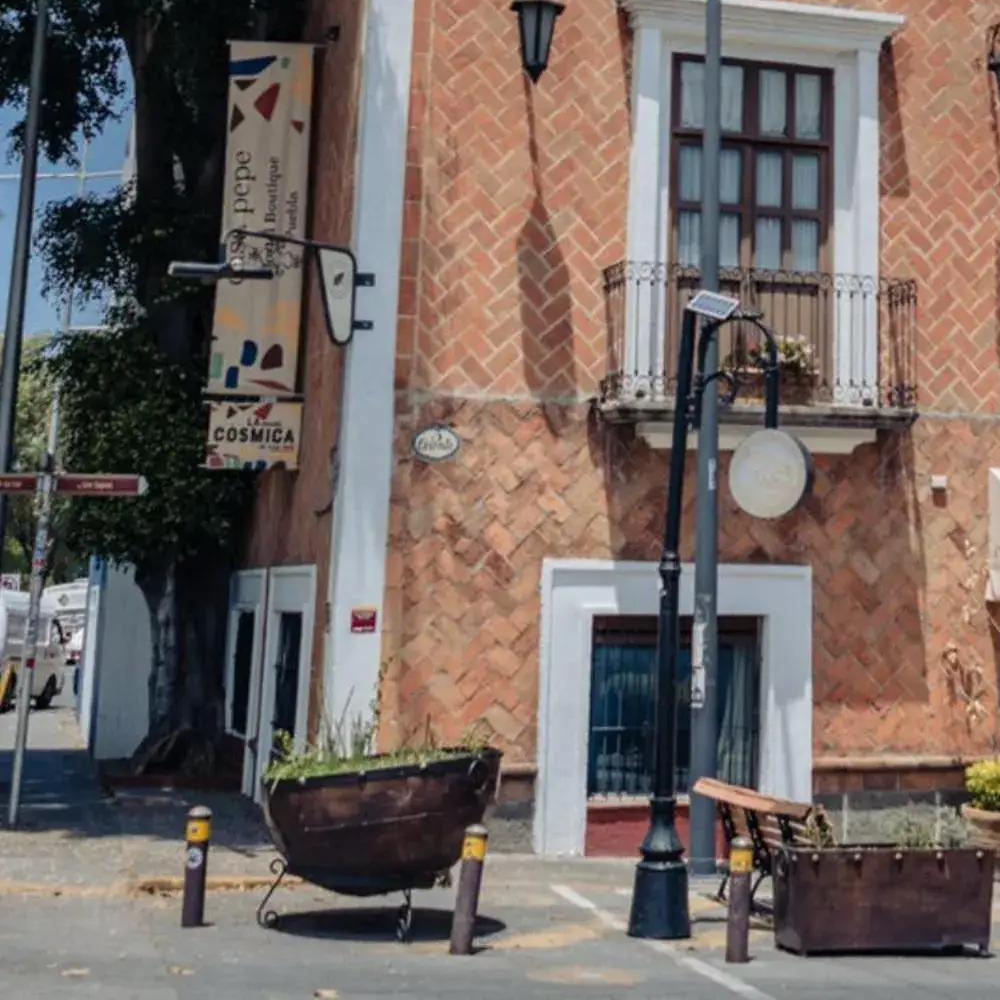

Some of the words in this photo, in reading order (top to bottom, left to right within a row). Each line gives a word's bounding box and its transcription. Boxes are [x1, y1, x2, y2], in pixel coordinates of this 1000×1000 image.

[232, 150, 256, 214] pepe
[264, 156, 282, 223] Boutique
[228, 224, 246, 285] csa
